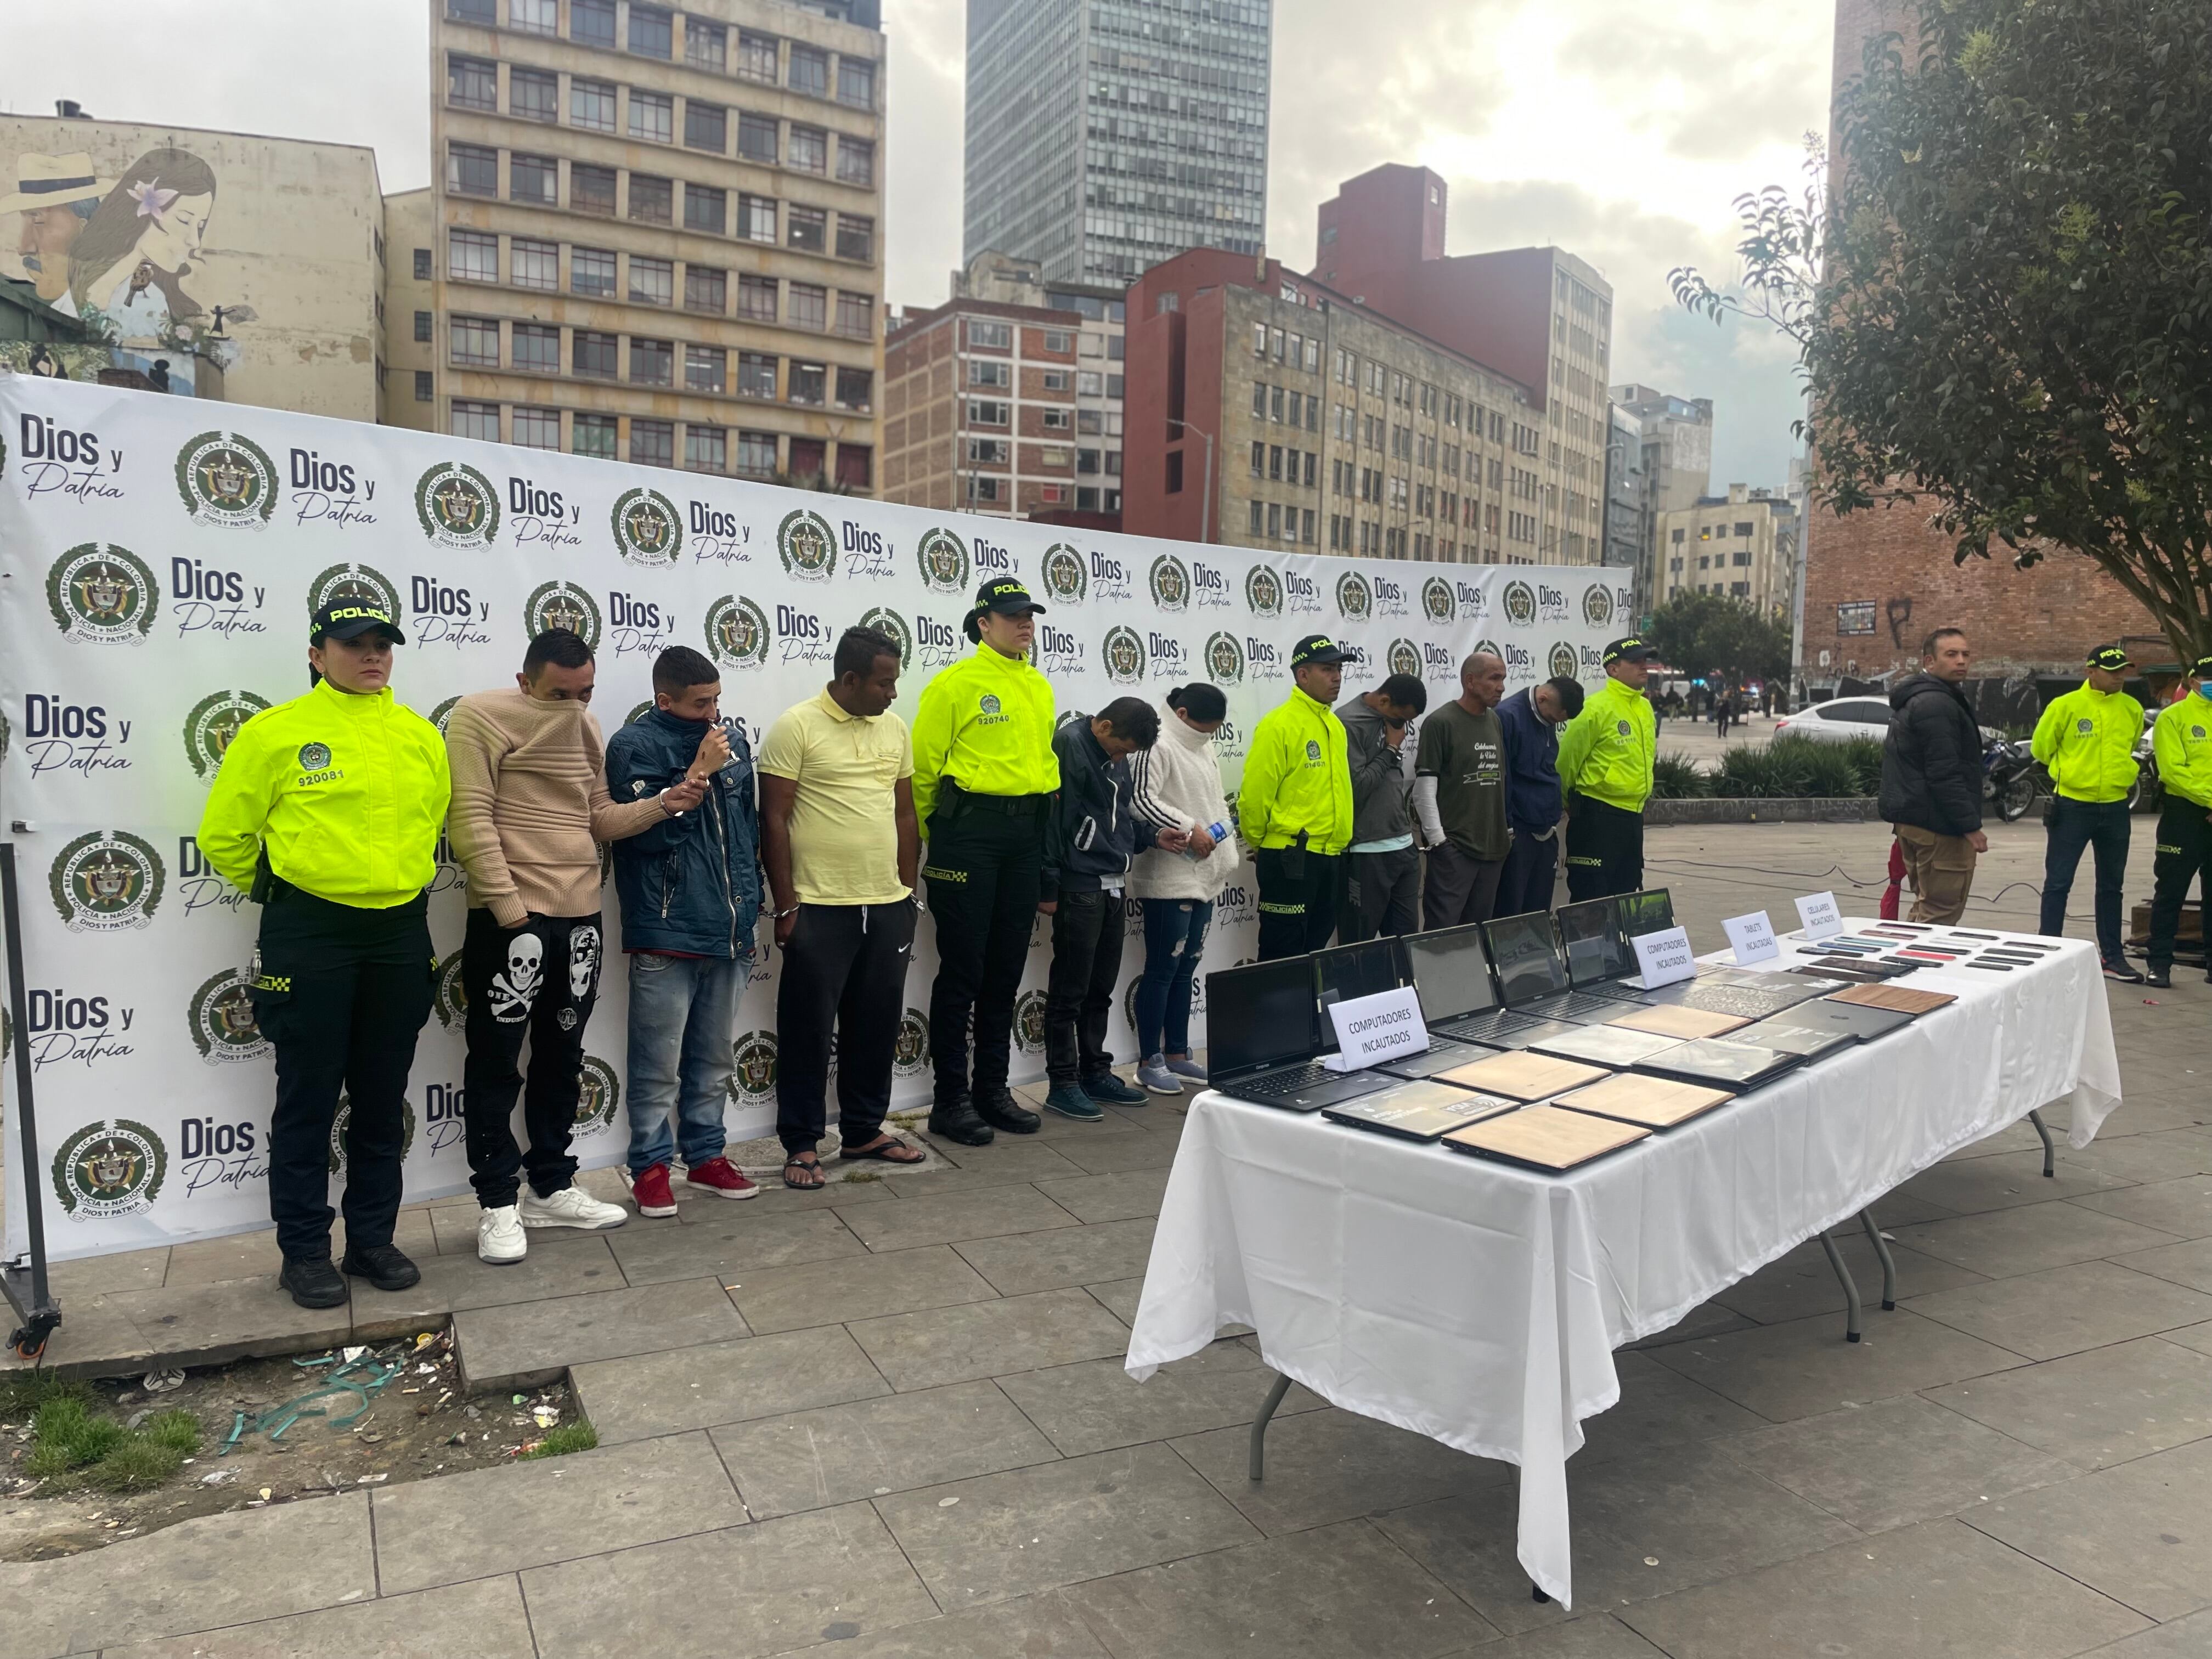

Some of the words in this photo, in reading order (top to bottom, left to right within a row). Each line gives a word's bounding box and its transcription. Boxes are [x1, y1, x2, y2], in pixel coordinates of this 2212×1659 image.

[21, 413, 99, 465] Dios
[111, 450, 122, 472] y
[189, 444, 214, 482] REPUBLICA
[242, 449, 267, 490] COLOMBIA
[290, 448, 356, 494] Dios
[365, 480, 375, 501] y
[22, 462, 124, 504] Patria
[427, 474, 447, 508] REPUBLICA
[470, 478, 490, 514] COLOMBIA
[230, 498, 264, 518] NACIONAL
[292, 492, 377, 529] Patria
[509, 477, 563, 518] Dios
[572, 506, 580, 524] y
[203, 513, 222, 526] DIOS
[230, 517, 256, 527] PATRIA
[460, 523, 488, 540] NACIONAL
[690, 500, 736, 537] Dios
[743, 526, 749, 543] y
[438, 535, 454, 546] DIOS
[460, 539, 482, 548] PATRIA
[511, 516, 582, 550] Patria
[843, 521, 882, 555] Dios
[888, 544, 893, 560] y
[692, 537, 752, 567] Patria
[974, 538, 1008, 568] Dios
[1013, 558, 1018, 573] y
[62, 557, 89, 597] REPUBLICA
[120, 561, 146, 602] COLOMBIA
[844, 554, 895, 582] Patria
[1091, 551, 1121, 580] Dios
[1126, 570, 1131, 584] y
[1194, 562, 1221, 589] Dios
[1225, 579, 1229, 592] y
[172, 557, 243, 602] Dios
[254, 587, 265, 608] y
[320, 577, 343, 607] EPUBLICA
[1093, 579, 1132, 603] Patria
[1286, 571, 1313, 595] Dios
[1316, 586, 1320, 598] y
[1374, 577, 1400, 600] Dios
[1403, 590, 1407, 602] y
[1457, 582, 1480, 604] Dios
[1482, 594, 1486, 605] y
[411, 575, 471, 616] Dios
[480, 602, 489, 622] y
[1196, 589, 1231, 611] Patria
[1289, 596, 1322, 617] Patria
[1539, 585, 1562, 606] Dios
[1565, 597, 1568, 608] y
[106, 611, 143, 633] NACIONAL
[174, 602, 267, 640] Patria
[610, 591, 660, 628] Dios
[667, 615, 674, 633] y
[1377, 600, 1409, 620] Patria
[1460, 604, 1489, 623] Patria
[1541, 606, 1569, 624] Patria
[77, 629, 97, 641] DIOS
[106, 632, 134, 642] PATRIA
[413, 616, 491, 650] Patria
[777, 605, 819, 638] Dios
[825, 626, 831, 642] y
[917, 616, 953, 646] Dios
[959, 635, 964, 651] y
[778, 639, 833, 666] Patria
[1042, 625, 1074, 653] Dios
[1079, 643, 1084, 657] y
[1149, 632, 1178, 658] Dios
[1182, 648, 1187, 661] y
[1247, 637, 1274, 661] Dios
[1278, 652, 1282, 664] y
[1044, 654, 1085, 678] Patria
[1368, 653, 1372, 665] y
[1424, 642, 1448, 664] Dios
[1451, 655, 1455, 667] y
[1505, 644, 1528, 665] Dios
[1531, 656, 1534, 667] y
[1581, 645, 1600, 665] Dios
[1151, 659, 1189, 681] Patria
[1249, 662, 1284, 682] Patria
[1342, 664, 1374, 684] Patria
[1427, 665, 1458, 685] Patria
[1508, 666, 1536, 684] Patria
[1582, 666, 1606, 682] Patria
[26, 694, 106, 738] Dios
[119, 721, 131, 743] y
[198, 704, 223, 743] REPUBLICA
[978, 715, 1009, 725] 920740
[753, 727, 760, 744] y
[1238, 730, 1242, 742] y
[26, 740, 132, 779] Patria
[298, 769, 345, 787] 920081
[65, 846, 94, 888] REPUBLICA
[125, 846, 151, 885] COLOMBIA
[110, 894, 148, 919] NACIONAL
[1249, 893, 1254, 907] y
[1808, 903, 1830, 915] CELULARES
[80, 918, 100, 929] DIOS
[110, 916, 139, 929] PATRIA
[1218, 906, 1255, 930] Patria
[1744, 923, 1762, 933] TABLETS
[1810, 915, 1834, 927] INCAUTADOS
[763, 944, 770, 961] y
[1647, 938, 1686, 954] COMPUTADORES
[1746, 938, 1773, 951] INCAUTADAS
[1656, 955, 1686, 970] INCAUTADOS
[29, 989, 109, 1032] Dios
[121, 1008, 133, 1031] y
[202, 982, 229, 1024] REPUBLICA
[1349, 1008, 1411, 1034] COMPUTADORES
[29, 1028, 134, 1073] Patria
[216, 1051, 234, 1060] DIOS
[242, 1047, 269, 1059] PATRIA
[1362, 1030, 1410, 1054] INCAUTADOS
[591, 1067, 610, 1098] COLOMBIA
[582, 1105, 607, 1129] NACIONAL
[182, 1117, 255, 1160] Dios
[67, 1133, 95, 1179] REPUBLICA
[127, 1132, 153, 1170] COLOMBIA
[112, 1177, 150, 1206] NACIONAL
[82, 1207, 103, 1217] DIOS
[111, 1201, 140, 1215] PATRIA
